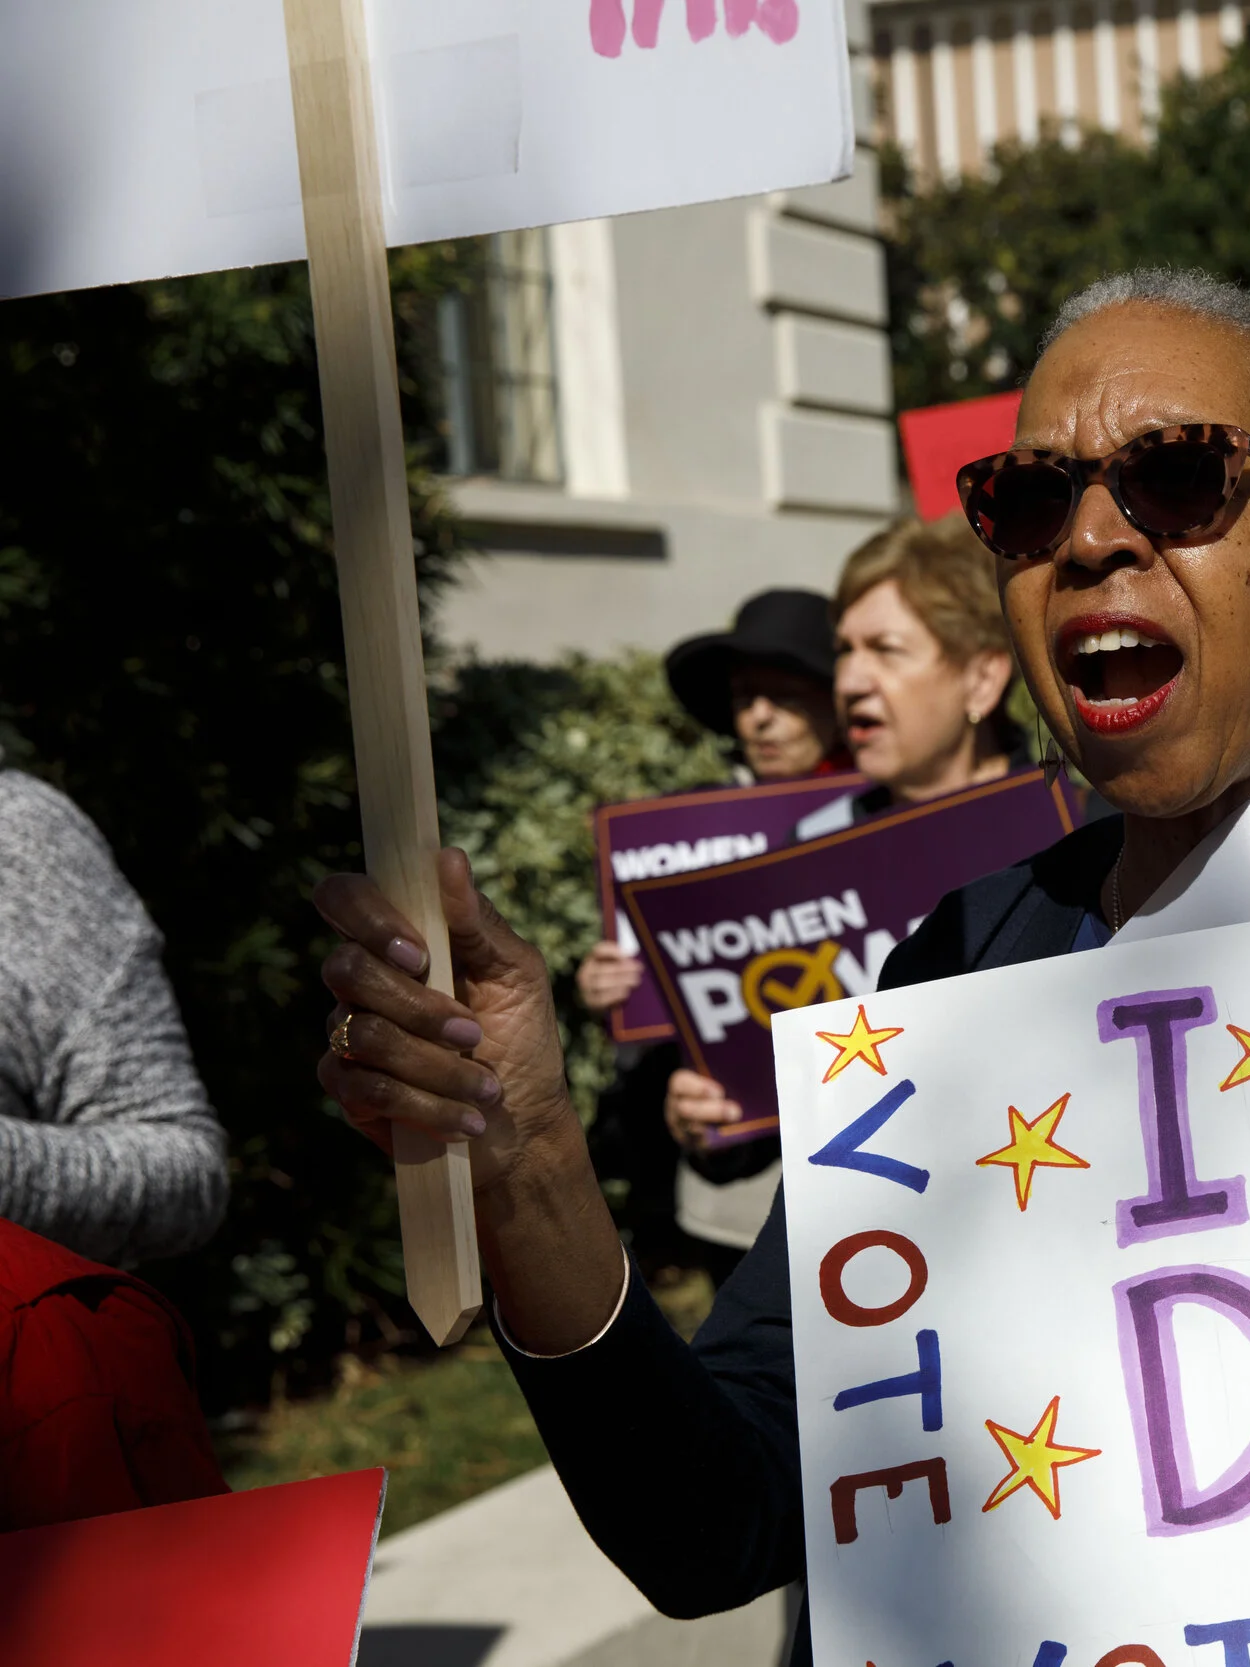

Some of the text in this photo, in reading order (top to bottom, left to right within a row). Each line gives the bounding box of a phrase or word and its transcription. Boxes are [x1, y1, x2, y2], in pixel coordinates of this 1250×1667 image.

[611, 831, 769, 882] WOMEN
[658, 888, 868, 967] WOMEN
[1096, 986, 1250, 1248] I
[808, 1078, 952, 1545] VOTE
